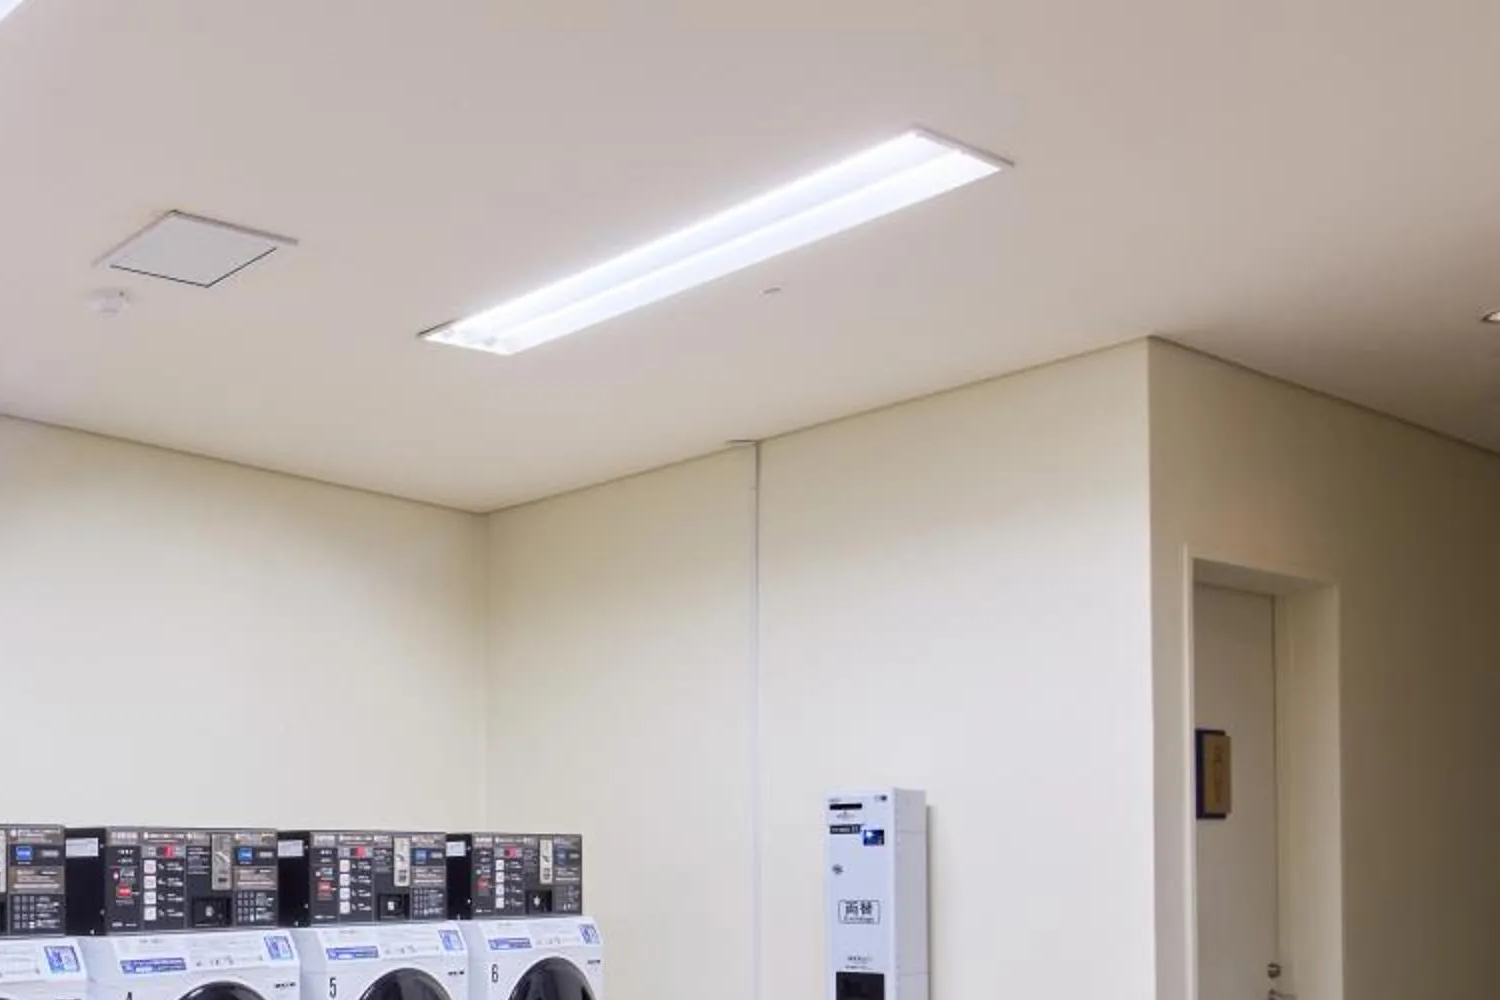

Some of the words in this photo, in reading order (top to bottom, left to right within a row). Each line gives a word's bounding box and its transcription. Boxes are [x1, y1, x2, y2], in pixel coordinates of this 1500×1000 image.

[845, 900, 873, 916] 両替
[491, 964, 499, 983] 6
[329, 977, 337, 998] 5
